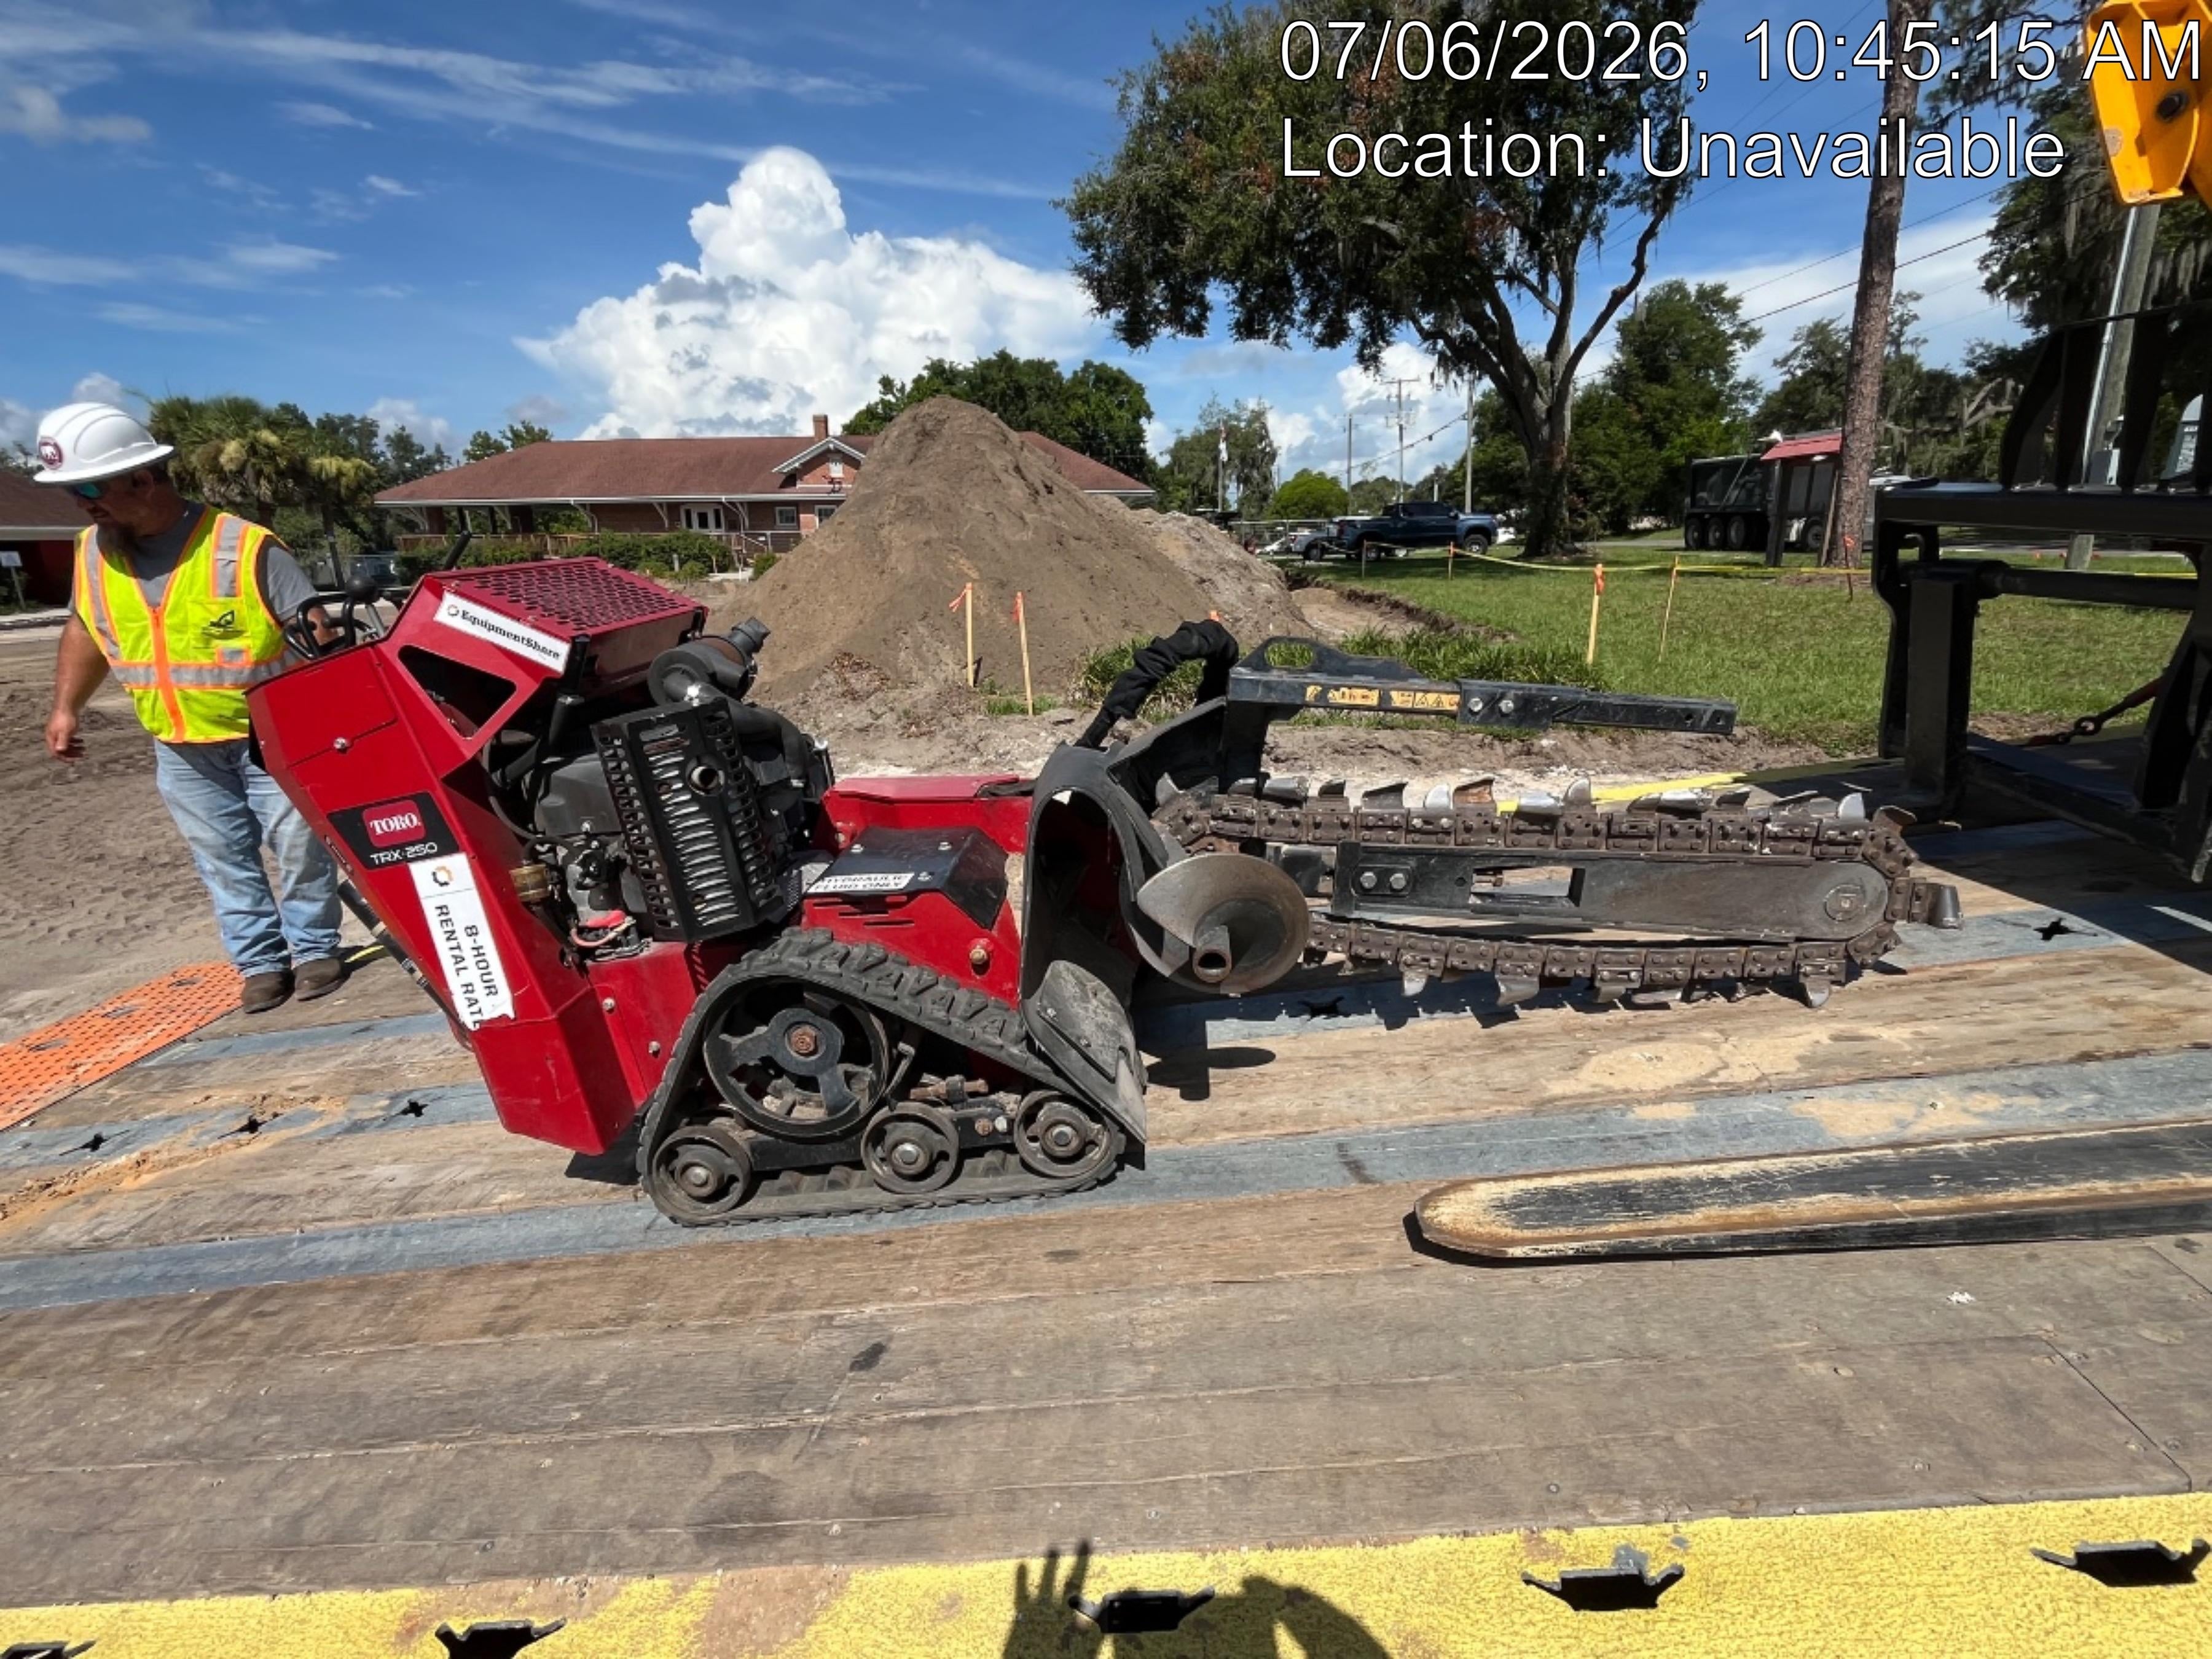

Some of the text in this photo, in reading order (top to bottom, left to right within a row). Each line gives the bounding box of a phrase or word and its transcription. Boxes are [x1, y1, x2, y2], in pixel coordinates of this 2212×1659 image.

[461, 609, 560, 660] EquipmentShare
[370, 812, 418, 836] TORO
[434, 904, 469, 976] RENTAL
[464, 924, 498, 997] 8-HOUR
